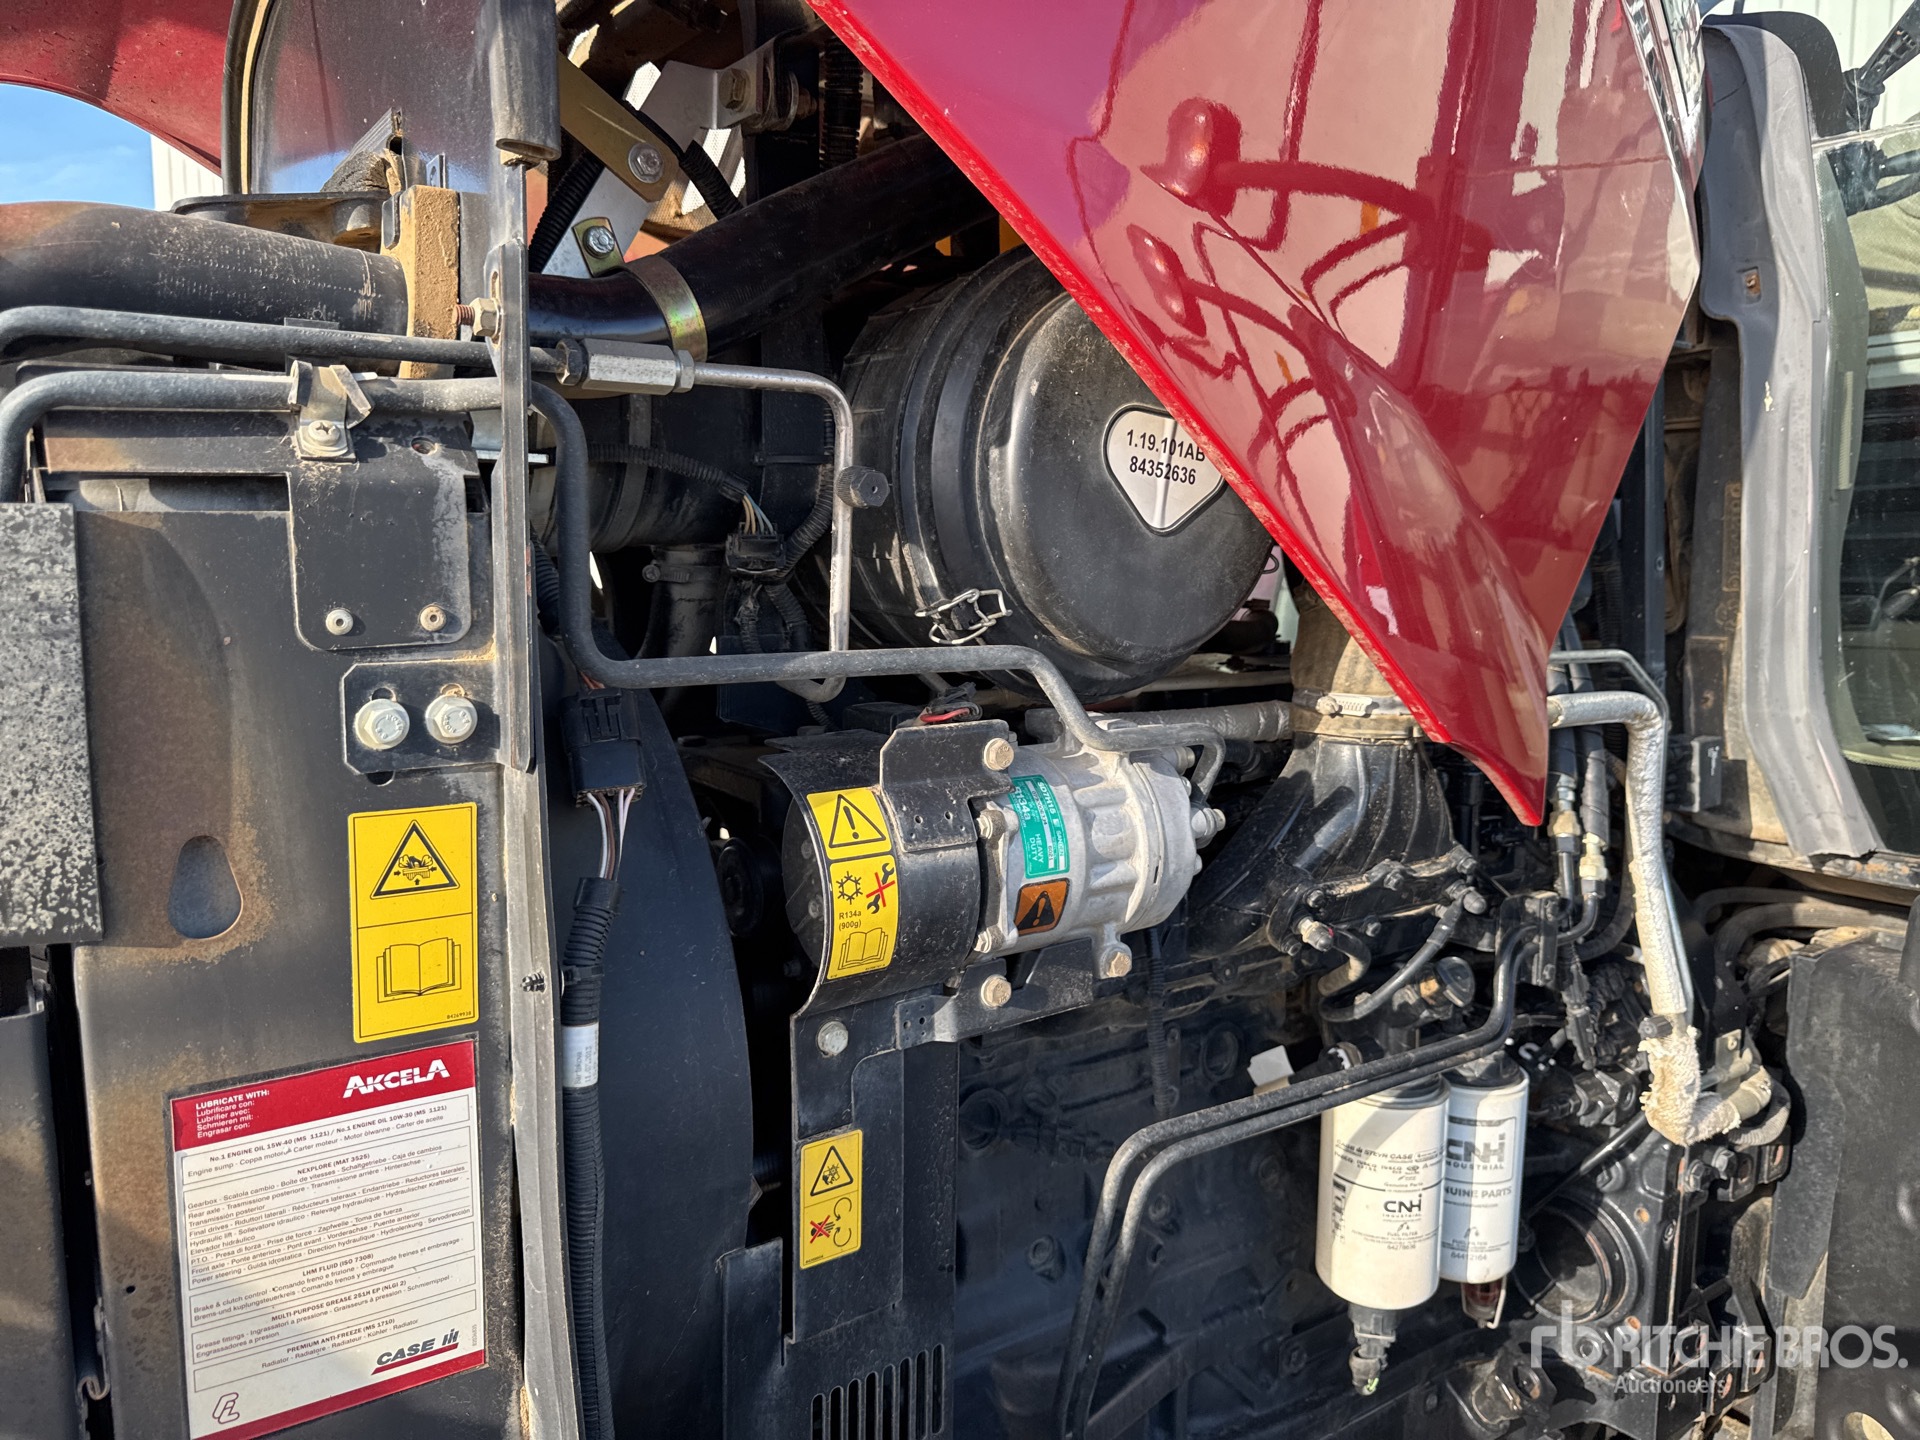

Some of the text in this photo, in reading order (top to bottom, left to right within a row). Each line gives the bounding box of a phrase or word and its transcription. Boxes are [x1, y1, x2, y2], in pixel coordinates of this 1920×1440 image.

[1127, 429, 1206, 462] 1.19.101AB
[1129, 456, 1197, 485] 84352636
[1037, 781, 1057, 815] SD7H15
[1029, 837, 1040, 861] DUTY
[1035, 833, 1045, 863] HEAVY
[838, 910, 862, 920] R134a
[838, 919, 862, 931] (900g)
[342, 1059, 450, 1098] AKCELA
[196, 1090, 269, 1109] LUBRICATE WITH:
[196, 1104, 236, 1116] Lubrificare
[196, 1113, 227, 1124] Lubrifier
[197, 1118, 237, 1130] Schmieren
[197, 1127, 231, 1138] Engrasar
[227, 1148, 252, 1158] ENGINE
[267, 1139, 292, 1149] 15W-40
[352, 1120, 375, 1129] ENGINE
[390, 1112, 412, 1121] 10W-30
[188, 1168, 212, 1177] Engine
[214, 1163, 233, 1171] sump
[239, 1156, 262, 1165] Coppa
[315, 1139, 338, 1147] moteur
[297, 1162, 331, 1174] NEXPLORE
[333, 1158, 349, 1166] (MAT
[188, 1199, 217, 1209] Gearbox
[223, 1191, 248, 1200] Scatola
[250, 1185, 274, 1194] cambio
[309, 1170, 335, 1179] vitesses
[341, 1158, 386, 1172] Schaltgetriebe
[417, 1146, 441, 1154] cambios
[272, 1187, 304, 1199] posteriore
[384, 1159, 420, 1171] Hinterachse
[1481, 1186, 1512, 1198] PARTS
[189, 1228, 206, 1237] Final
[208, 1224, 228, 1232] drives
[234, 1215, 262, 1226] Riduttori
[264, 1209, 286, 1218] laterali
[331, 1192, 356, 1201] lateraux
[405, 1172, 439, 1183] Reductores
[440, 1166, 464, 1175] laterales
[190, 1235, 222, 1247] Hydraulic
[277, 1215, 305, 1225] idraulico
[311, 1205, 340, 1216] Relevage
[342, 1196, 380, 1208] hydraulique
[385, 1184, 427, 1197] Hydraulischer
[235, 1205, 264, 1216] posterior
[190, 1244, 220, 1255] Elevador
[191, 1266, 209, 1274] Front
[231, 1256, 250, 1264] Ponte
[252, 1248, 281, 1259] anteriore
[287, 1242, 302, 1250] Pont
[304, 1237, 321, 1246] avant
[327, 1226, 367, 1239] Vorderachse
[373, 1219, 395, 1227] Puente
[397, 1212, 419, 1221] anterior
[192, 1276, 212, 1284] Power
[215, 1268, 241, 1279] steering
[247, 1262, 266, 1270] Guida
[307, 1244, 336, 1255] Direction
[338, 1233, 374, 1246] hydraulique
[380, 1221, 422, 1235] Hydrolenkung
[216, 1250, 234, 1258] Presa
[301, 1281, 332, 1293] Comando
[334, 1275, 355, 1284] frenos
[362, 1264, 393, 1276] embrague
[302, 1259, 352, 1276] LHM FLUID (ISO
[194, 1304, 213, 1313] Brake
[222, 1296, 242, 1305] clutch
[244, 1289, 267, 1299] control
[273, 1280, 305, 1292] Comando
[360, 1255, 396, 1268] Commande
[271, 1303, 323, 1321] MULTI-PURPOSE
[326, 1296, 351, 1306] GREASE
[382, 1282, 398, 1291] (NLGI
[196, 1340, 220, 1350] Grease
[250, 1321, 288, 1335] Ingrassatori
[296, 1311, 328, 1323] pressione
[333, 1300, 367, 1312] Graisseurs
[287, 1340, 319, 1353] PREMIUM
[321, 1328, 361, 1344] ANTI-FREEZE
[363, 1324, 375, 1332] (MS
[261, 1319, 418, 1368] Radiator Radiatore Radiateur Kühler Radiator
[377, 1338, 435, 1365] CASE
